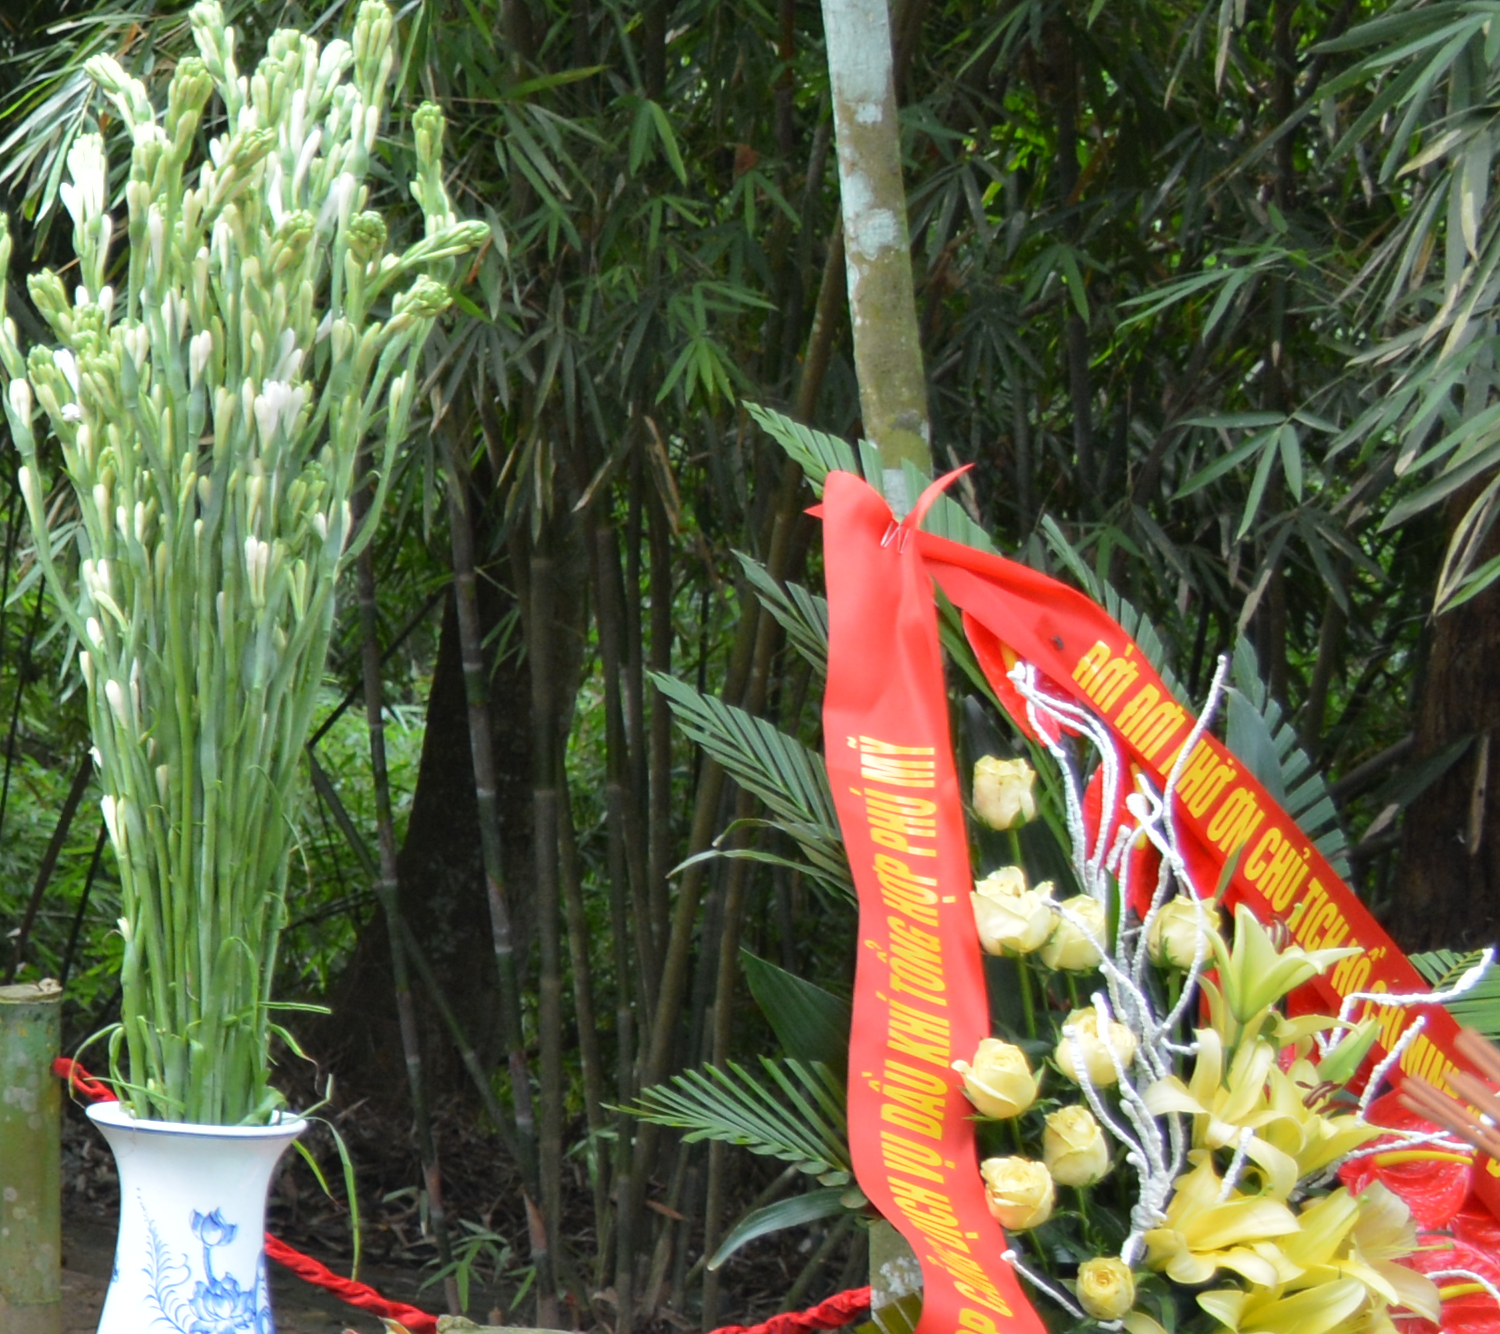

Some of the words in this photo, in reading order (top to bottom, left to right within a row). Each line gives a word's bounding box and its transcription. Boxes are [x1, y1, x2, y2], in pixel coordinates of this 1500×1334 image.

[846, 735, 935, 788] MỸ
[849, 786, 937, 857] PHÚ
[1206, 787, 1265, 857] ƠN
[1243, 827, 1311, 912] CHỦ
[872, 853, 955, 927] HỢP
[864, 916, 947, 1007] TỔNG
[875, 990, 950, 1068] KHÍ
[861, 1059, 949, 1140] DẦU
[880, 1130, 955, 1185] VỤ
[887, 1175, 979, 1254] DỊCH
